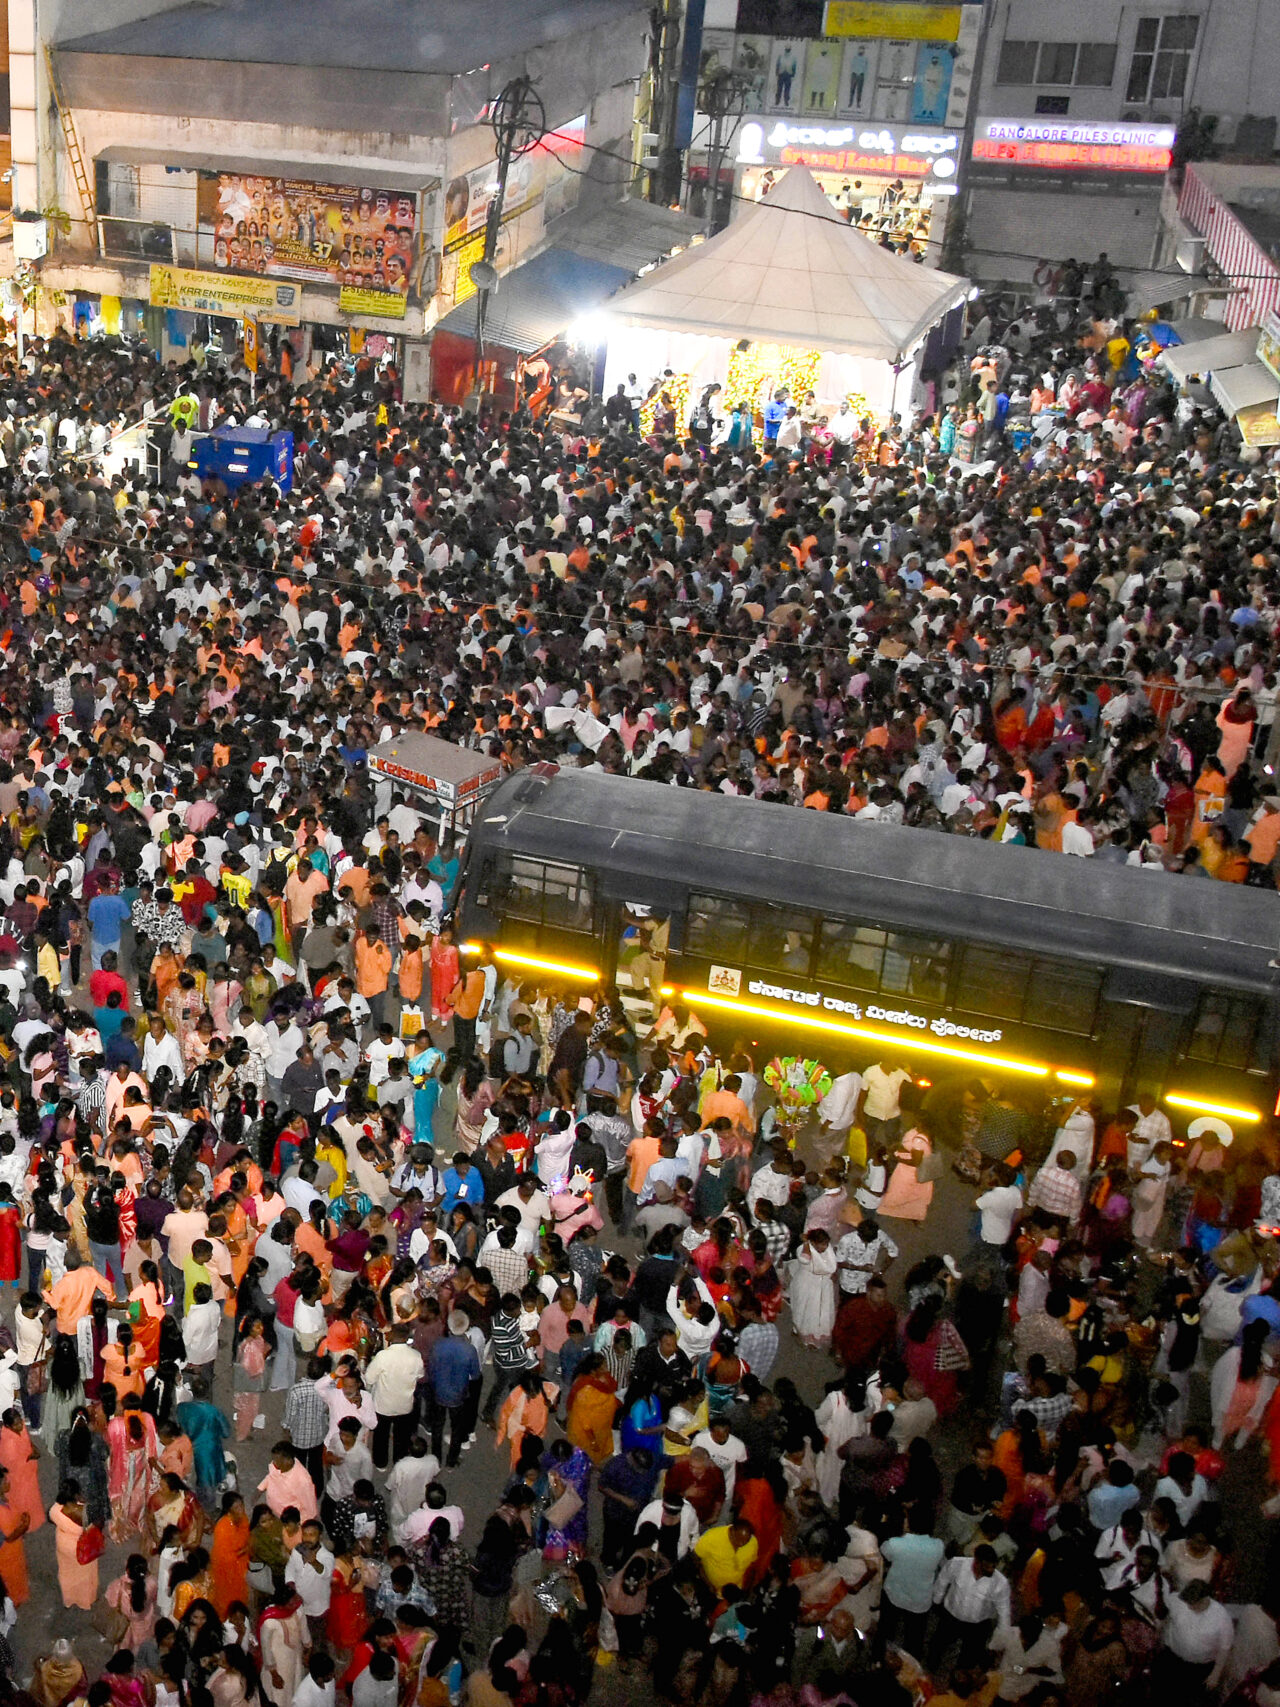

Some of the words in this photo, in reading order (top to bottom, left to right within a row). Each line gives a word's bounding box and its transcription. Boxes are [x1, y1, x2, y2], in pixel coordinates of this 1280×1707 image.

[989, 126, 1069, 141] BANGALORE
[1072, 130, 1109, 142] PILES
[1112, 132, 1156, 145] CLINIC
[847, 152, 894, 171] Lassi
[895, 157, 931, 174] Bar
[1103, 147, 1171, 166] FISTULA
[312, 240, 333, 259] 37
[203, 288, 273, 306] ENTERPRISES
[377, 758, 438, 792] KRISHNA
[748, 979, 822, 1007] ಕರ್ನಾಟಕ
[823, 996, 863, 1021] ರಾಜ್ಯ
[865, 1004, 927, 1030] ಮೀಸಲು
